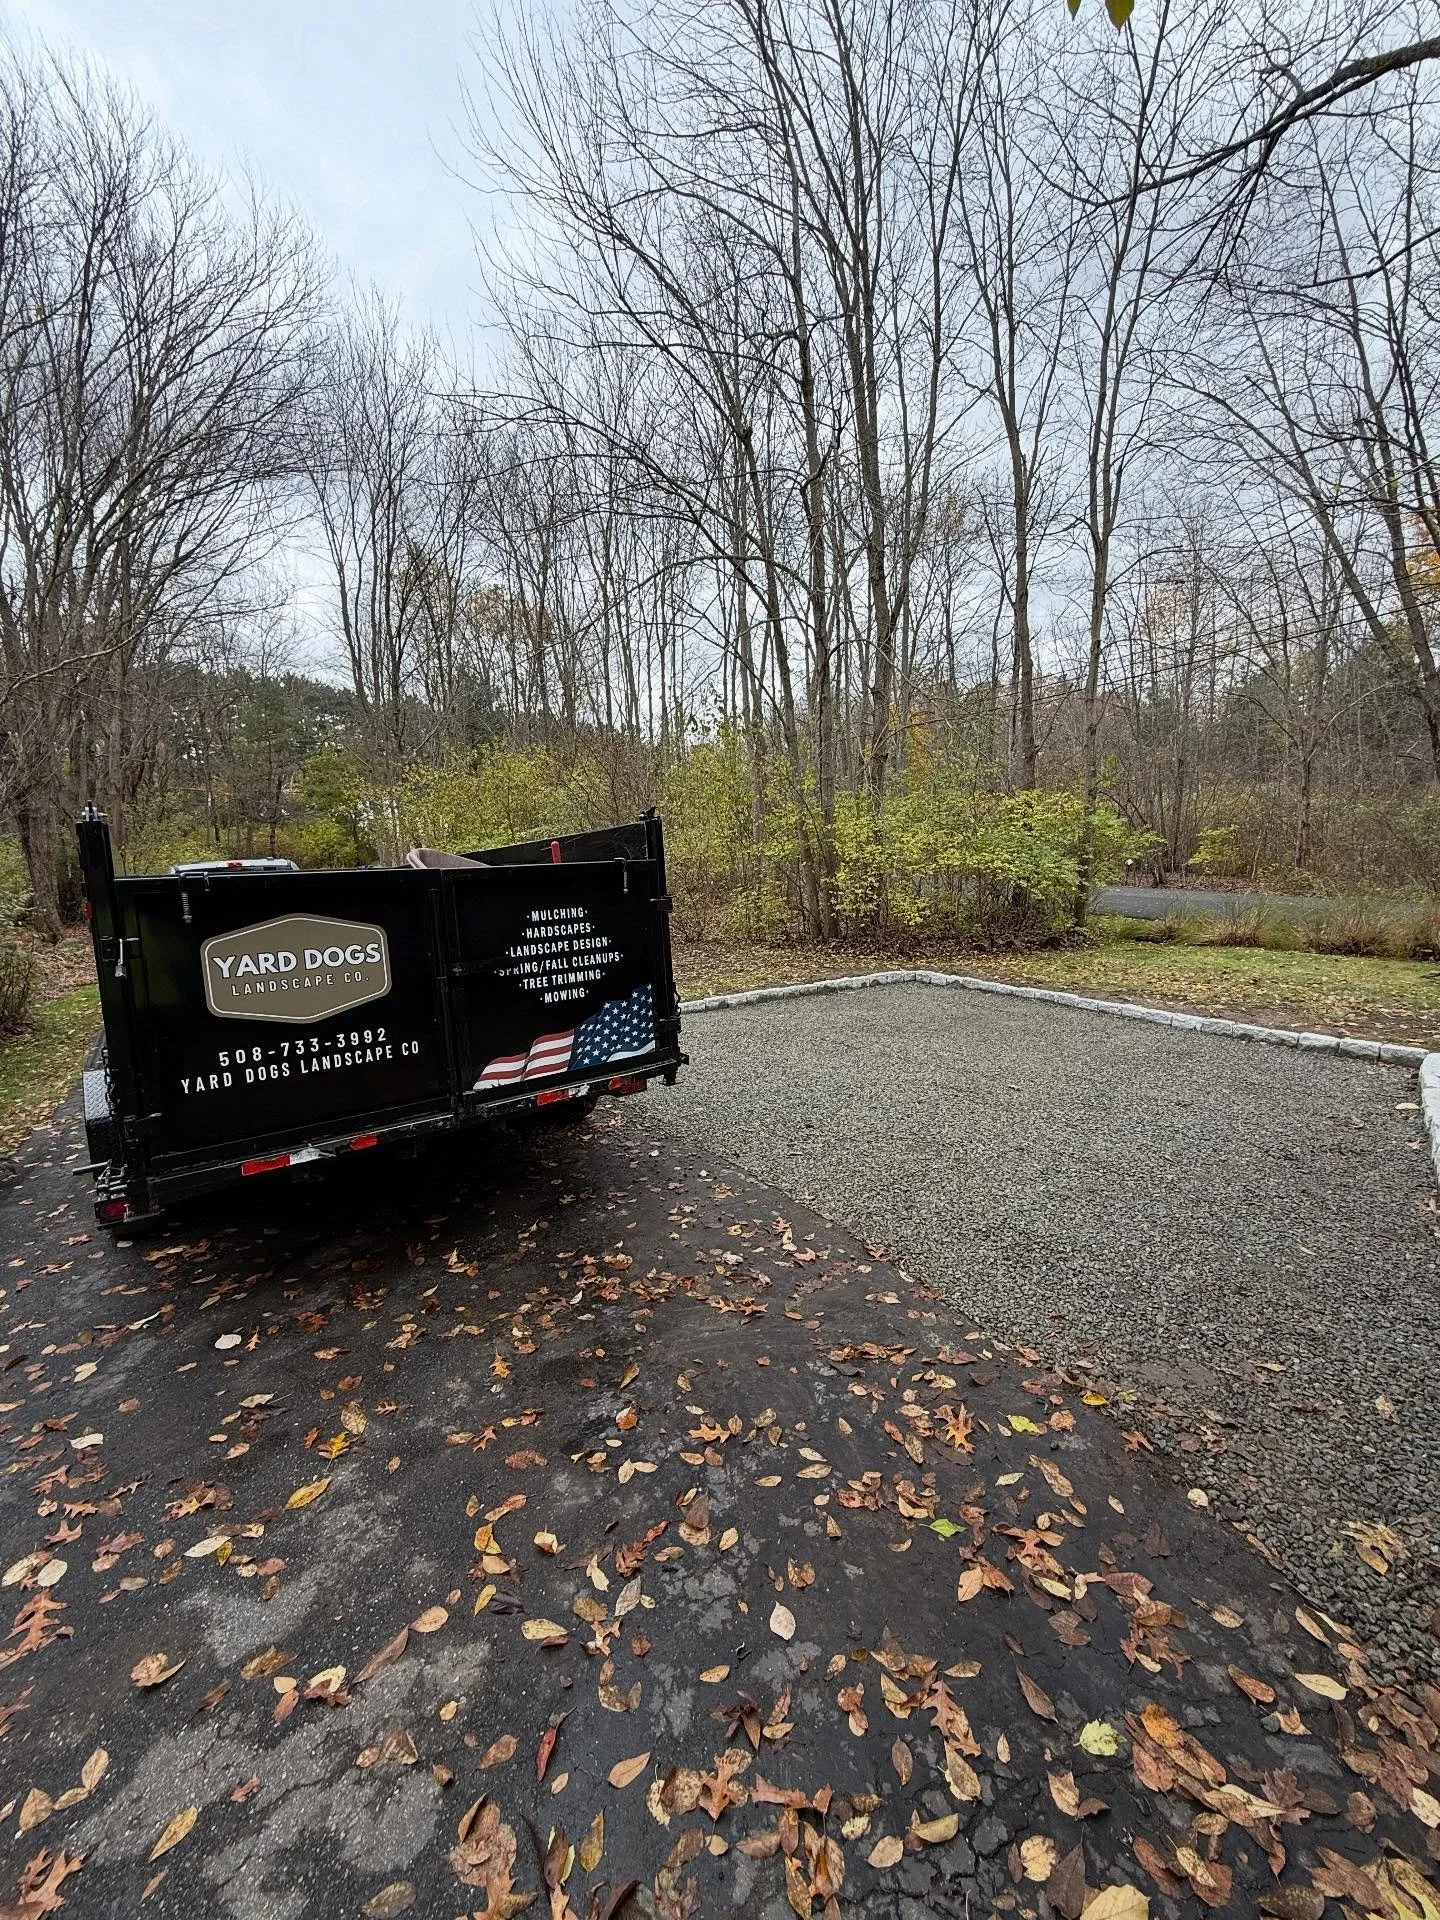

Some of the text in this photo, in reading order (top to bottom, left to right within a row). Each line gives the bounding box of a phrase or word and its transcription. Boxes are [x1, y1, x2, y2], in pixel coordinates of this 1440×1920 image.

[531, 907, 584, 922] MULCHING
[526, 922, 591, 939] HARDSCAPES
[510, 936, 608, 958] LANDSCAPE DESIGN
[212, 942, 382, 979] YARD DOGS
[572, 951, 620, 967] CLEANUPS
[231, 971, 370, 996] LANDSCAPE CO.
[522, 969, 601, 990] TREE TRIMMING
[218, 1028, 387, 1067] 508-733-3992
[180, 1040, 420, 1094] YARD DOGS LANDSCAPE CO
